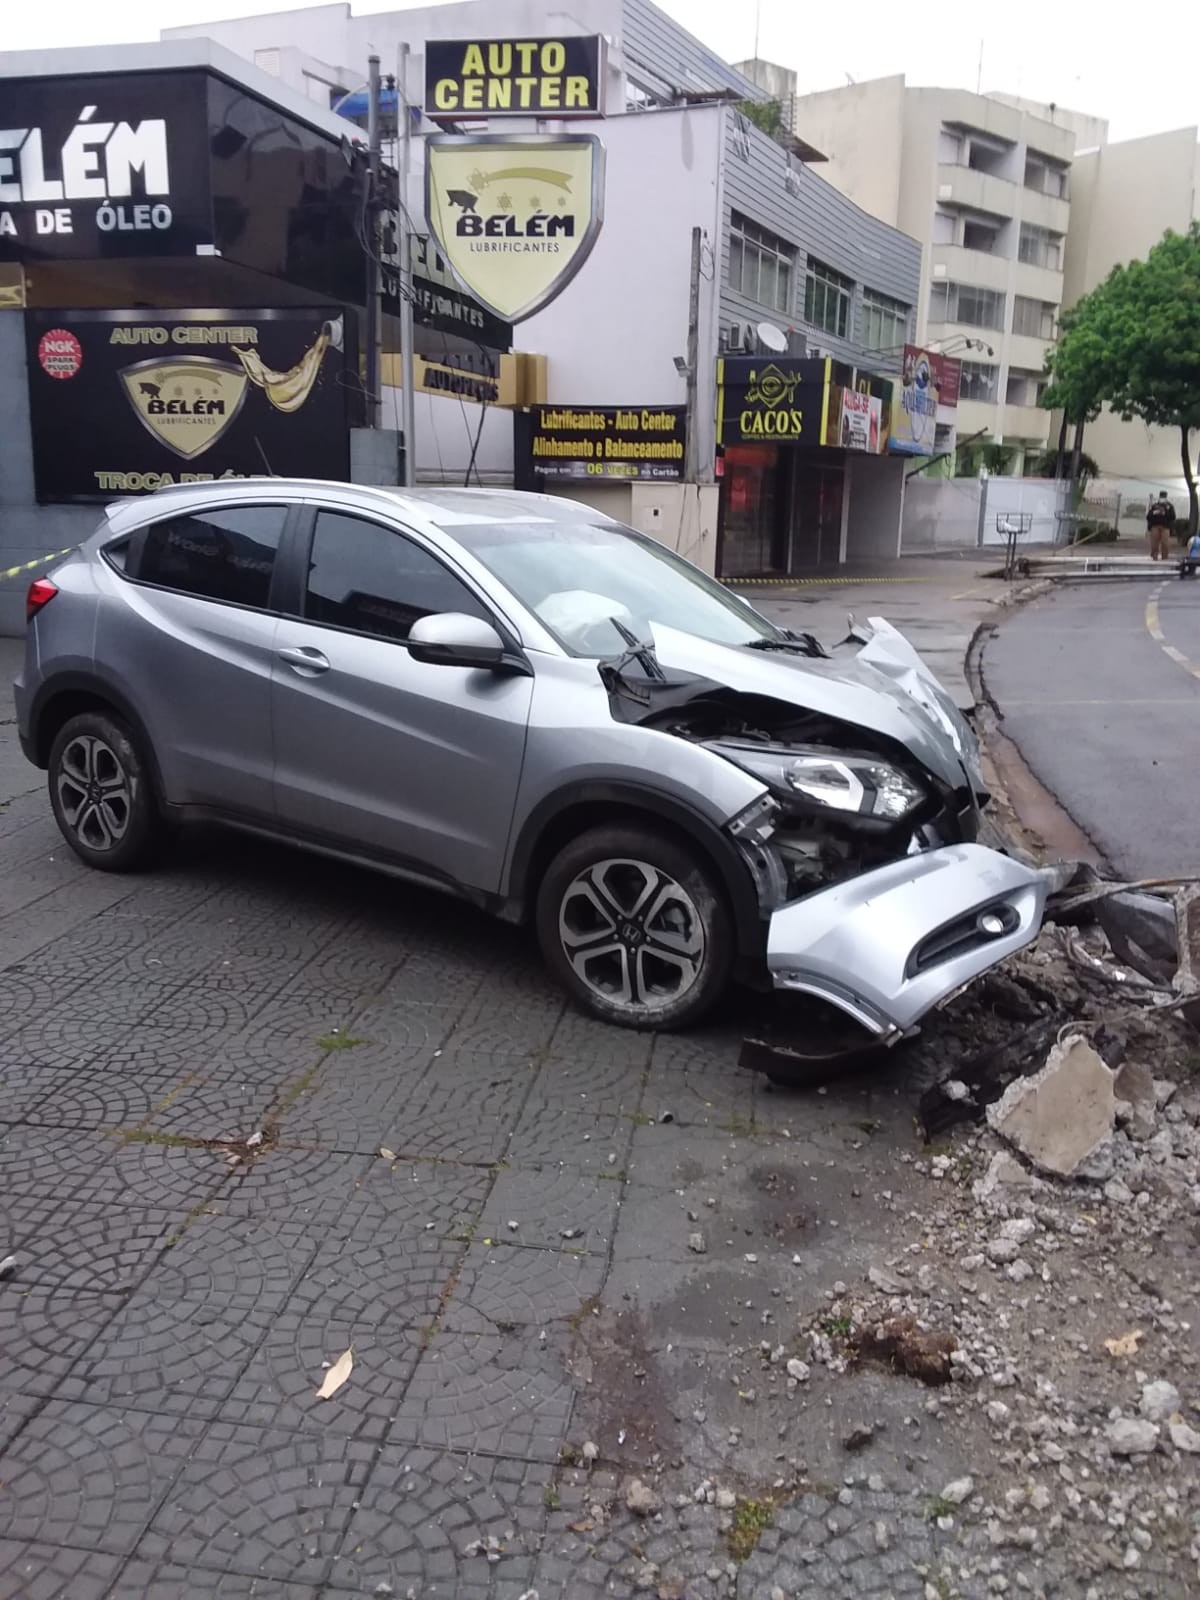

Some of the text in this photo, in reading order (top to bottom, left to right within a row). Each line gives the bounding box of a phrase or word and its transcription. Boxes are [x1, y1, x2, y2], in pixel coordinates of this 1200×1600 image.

[461, 42, 566, 76] AUTO
[434, 76, 589, 110] CENTER
[35, 208, 73, 235] DE
[96, 200, 172, 232] ÓLEO
[456, 208, 575, 237] BELÉM
[469, 241, 560, 254] LUBRIFICANTES
[110, 326, 258, 345] AUTO CENTER
[44, 340, 75, 353] NGK
[148, 396, 225, 415] BELÉM
[156, 417, 217, 425] LUBRIFICANTES
[541, 409, 606, 430] Lubrificantes
[615, 410, 639, 430] Auto
[641, 410, 676, 430] Center
[740, 408, 803, 434] CACO'S
[532, 436, 684, 459] Alinhamento e Balanceamento
[587, 463, 603, 475] 06
[607, 466, 639, 477] VEZES
[652, 467, 680, 477] Cartão
[94, 472, 175, 490] TROCA
